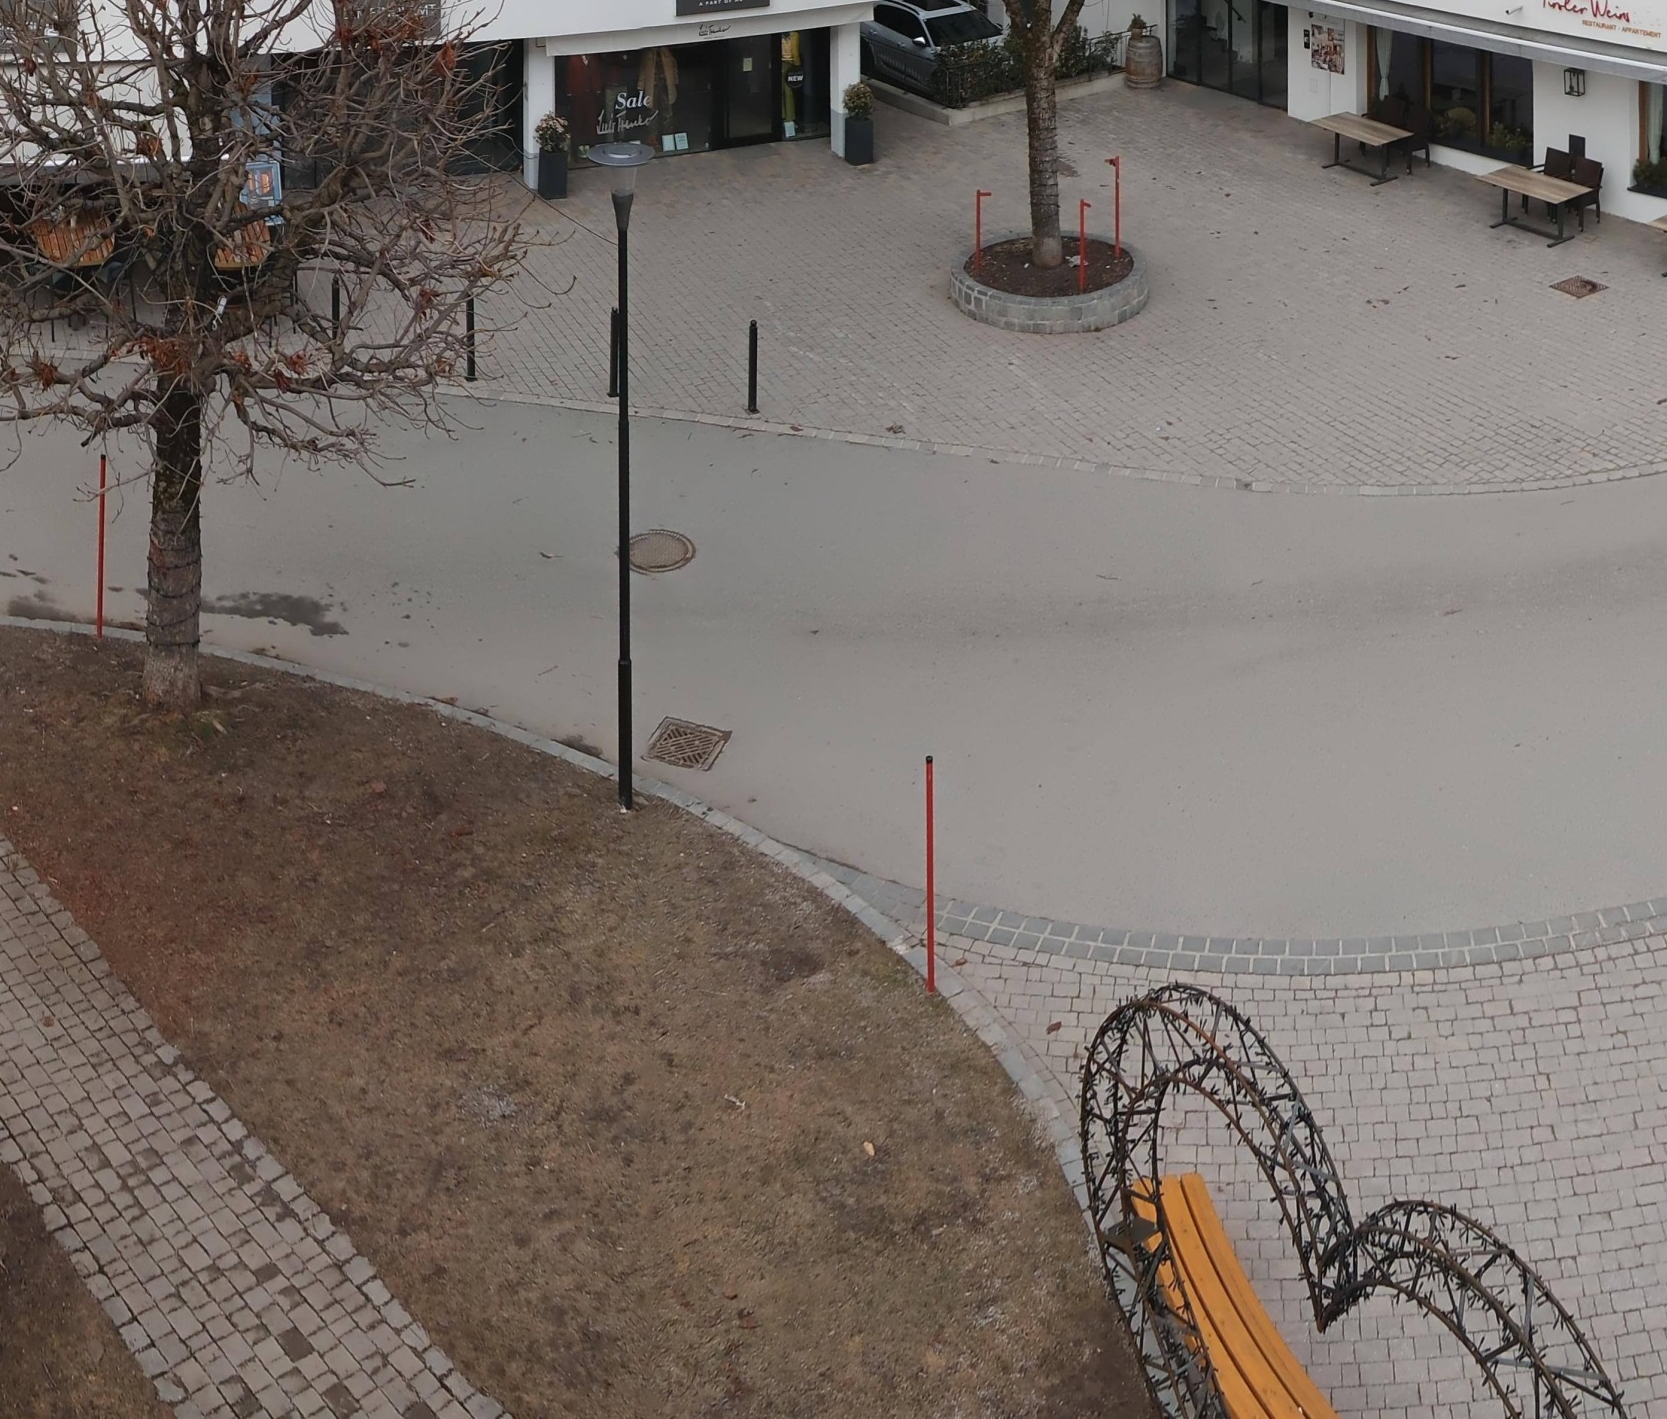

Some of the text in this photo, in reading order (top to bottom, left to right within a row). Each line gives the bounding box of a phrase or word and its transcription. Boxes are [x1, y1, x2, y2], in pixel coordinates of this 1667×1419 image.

[1582, 19, 1662, 38] RESTAURANT APPARTEMENT
[615, 90, 652, 110] Sale
